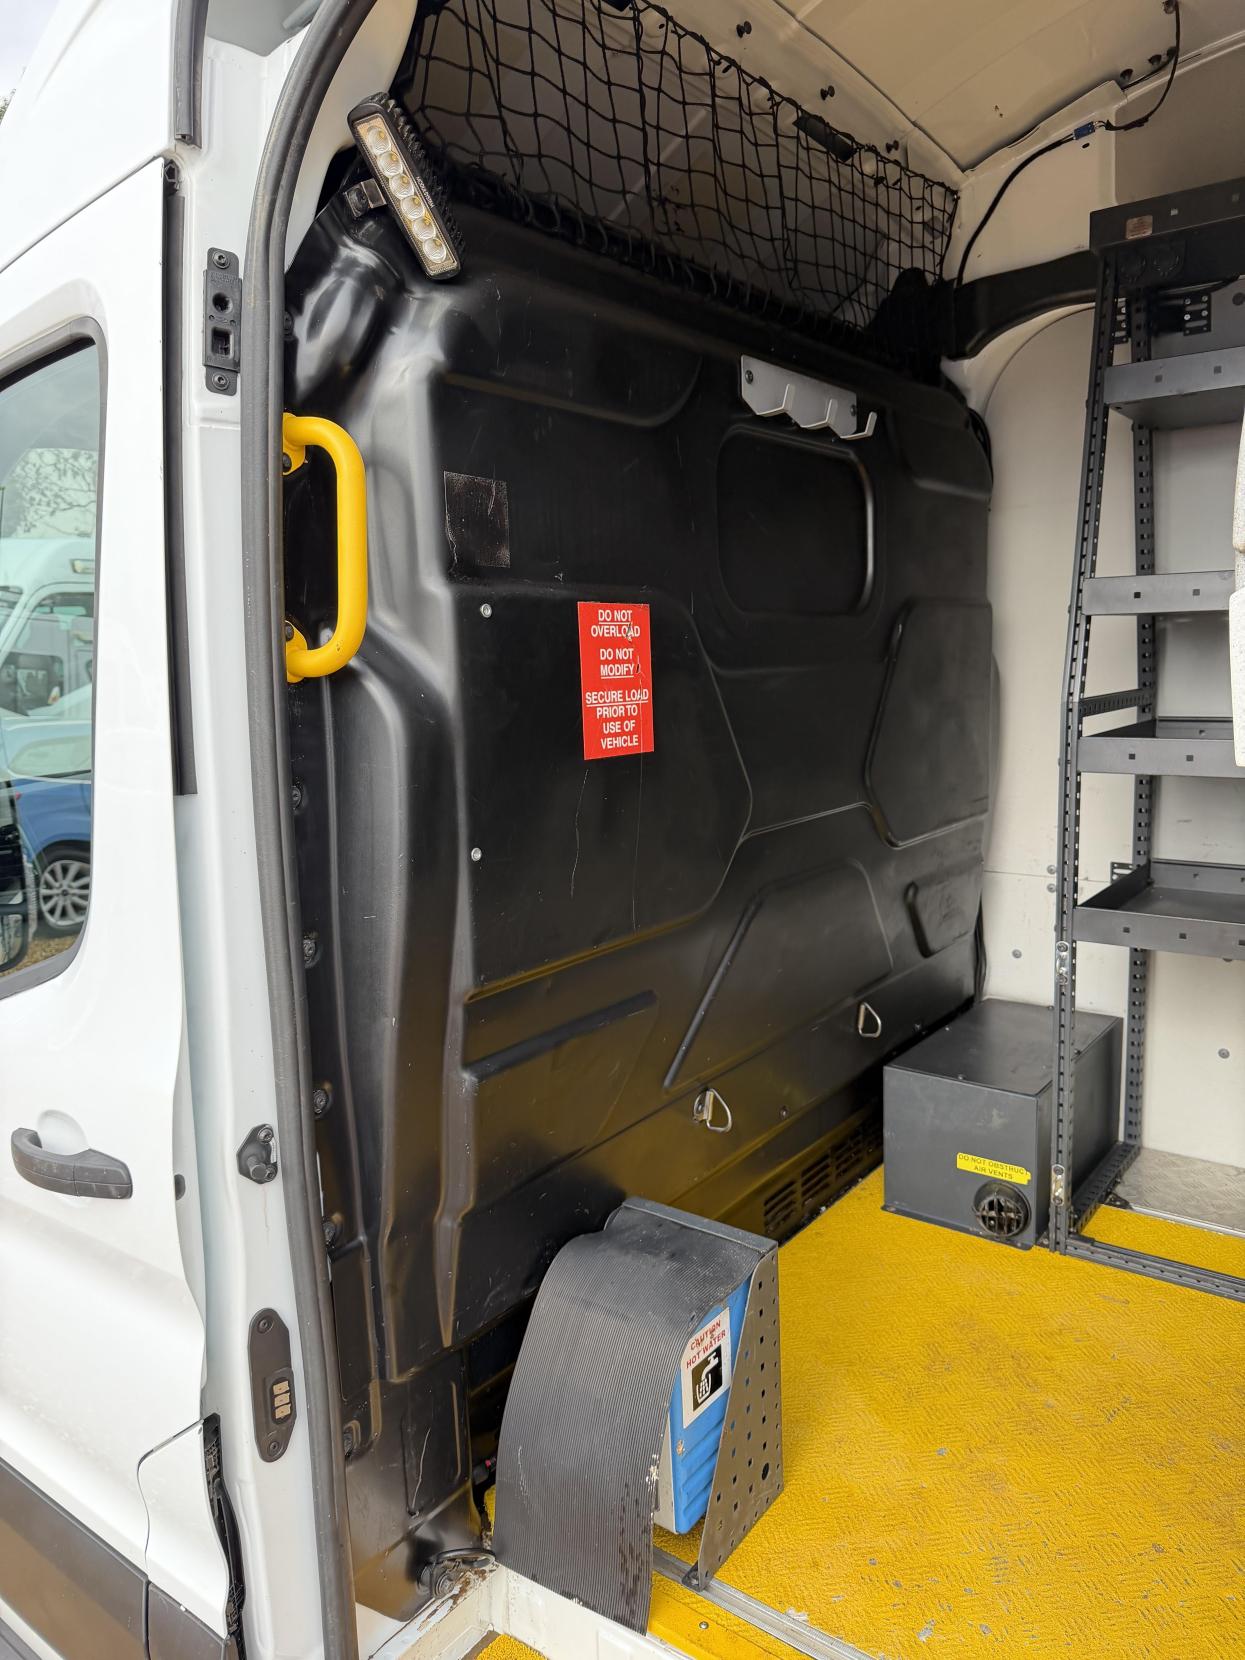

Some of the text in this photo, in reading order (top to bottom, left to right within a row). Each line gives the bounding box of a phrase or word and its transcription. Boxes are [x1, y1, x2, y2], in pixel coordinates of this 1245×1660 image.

[598, 610, 632, 622] DO NOT
[591, 625, 640, 638] OVERLOAD
[600, 648, 634, 660] DO NOT
[600, 664, 635, 676] MODIFY
[585, 688, 649, 704] SECURE LOAD
[596, 705, 638, 719] PRIOR TO
[603, 720, 636, 734] USE OF
[600, 735, 638, 749] VEHICLE
[971, 1156, 986, 1165] NOT
[988, 1169, 1013, 1179] VENTS
[690, 1319, 721, 1350] CAUTION
[686, 1329, 726, 1369] HOT WATER
